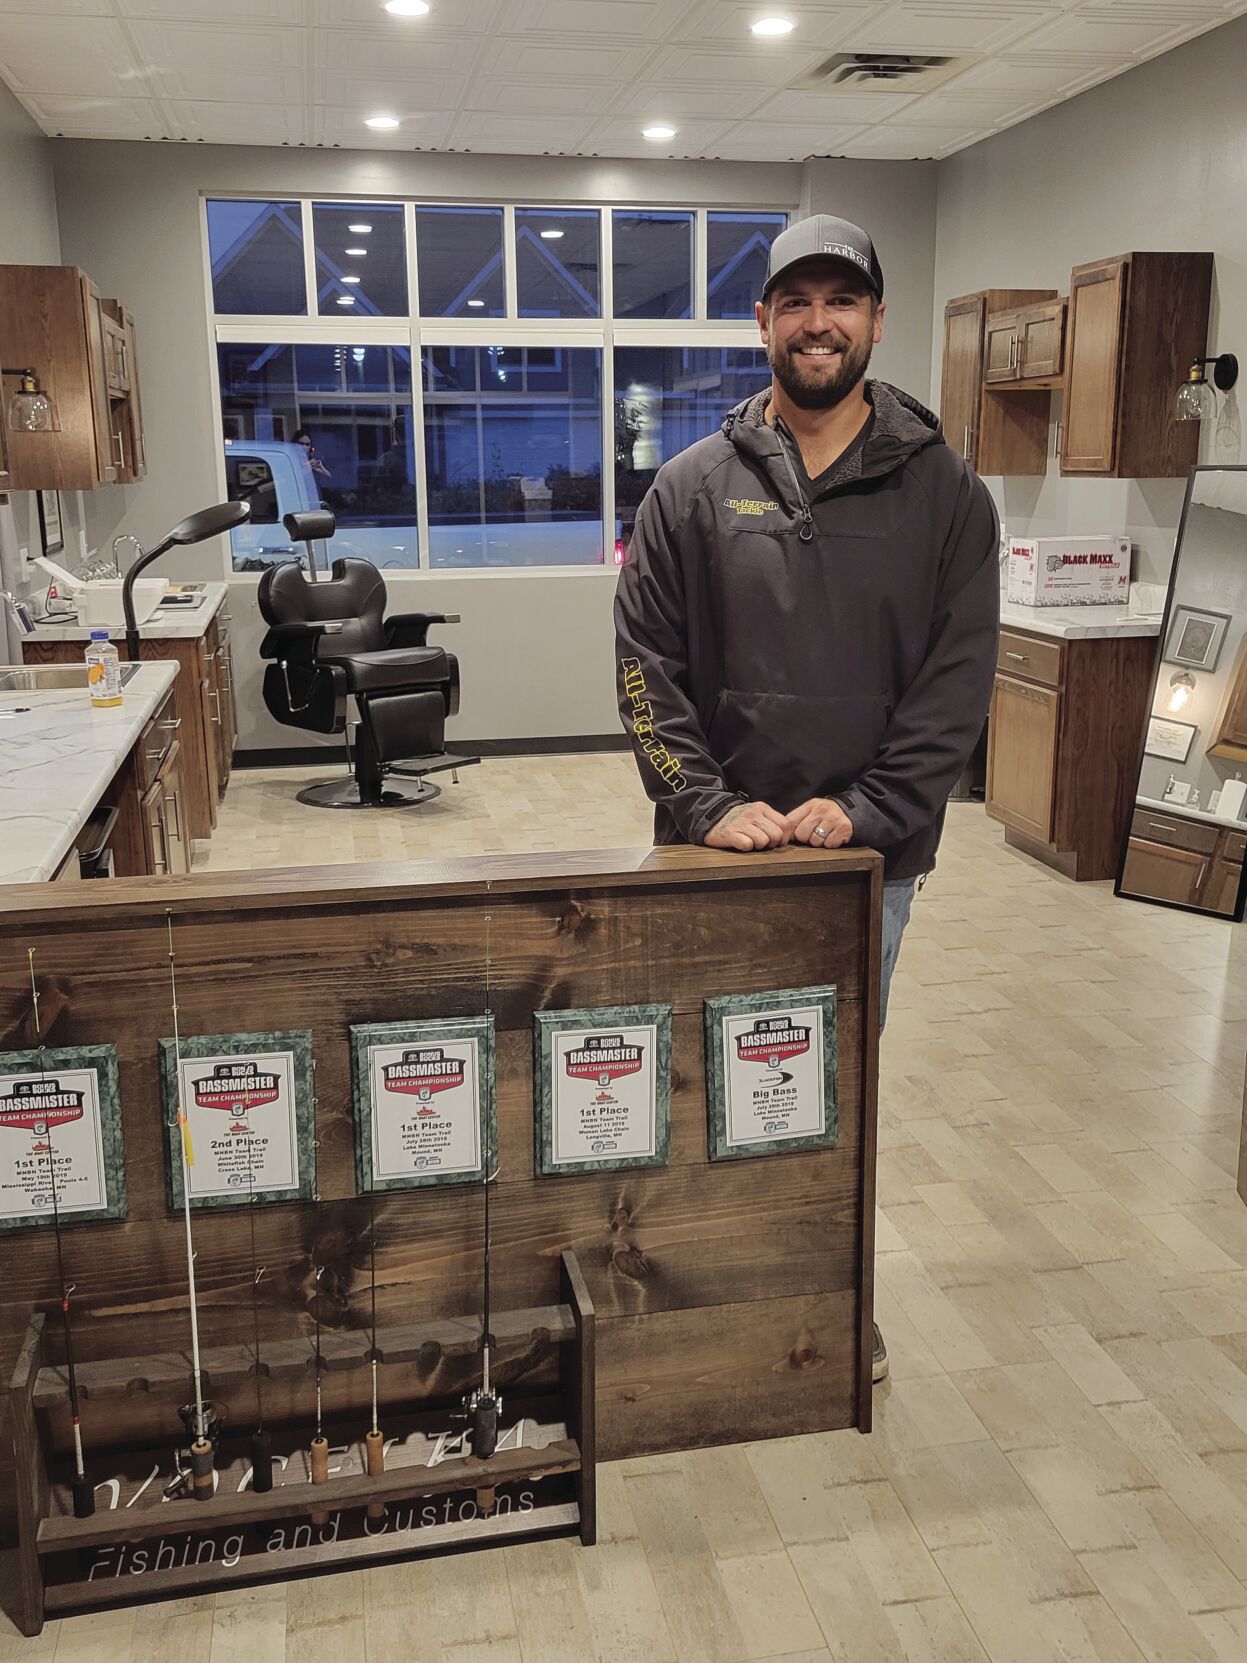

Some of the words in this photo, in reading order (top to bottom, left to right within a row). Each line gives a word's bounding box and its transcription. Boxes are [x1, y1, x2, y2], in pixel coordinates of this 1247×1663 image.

[824, 245, 868, 269] HARBOR
[723, 499, 779, 510] All-Terrain
[736, 508, 764, 516] Tackle
[1062, 554, 1088, 565] BLACK
[1090, 554, 1113, 564] MAXX
[621, 657, 686, 793] All-Terrain
[741, 1029, 806, 1048] BASSMASTER
[760, 1044, 808, 1054] CHAMPIONSHIP
[570, 1048, 637, 1064] BASSMASTER
[388, 1062, 459, 1078] BASSMASTER
[589, 1062, 640, 1072] CHAMPIONSHIP
[199, 1076, 274, 1093] BASSMASTER
[408, 1076, 462, 1086] CHAMPIONSHIP
[220, 1092, 277, 1101] CHAMPIONSHIP
[773, 1088, 797, 1096] Bass
[0, 1094, 77, 1112] BASSMASTER
[580, 1109, 596, 1117] 1st
[600, 1107, 628, 1115] Place
[401, 1124, 418, 1132] 1st
[422, 1122, 452, 1130] Place
[211, 1140, 232, 1149] 2nd
[237, 1138, 268, 1146] Place
[14, 1160, 34, 1168] 1st
[38, 1157, 72, 1166] Place
[88, 1533, 244, 1582] Fishing
[266, 1512, 341, 1553] and
[364, 1490, 534, 1537] Customs
